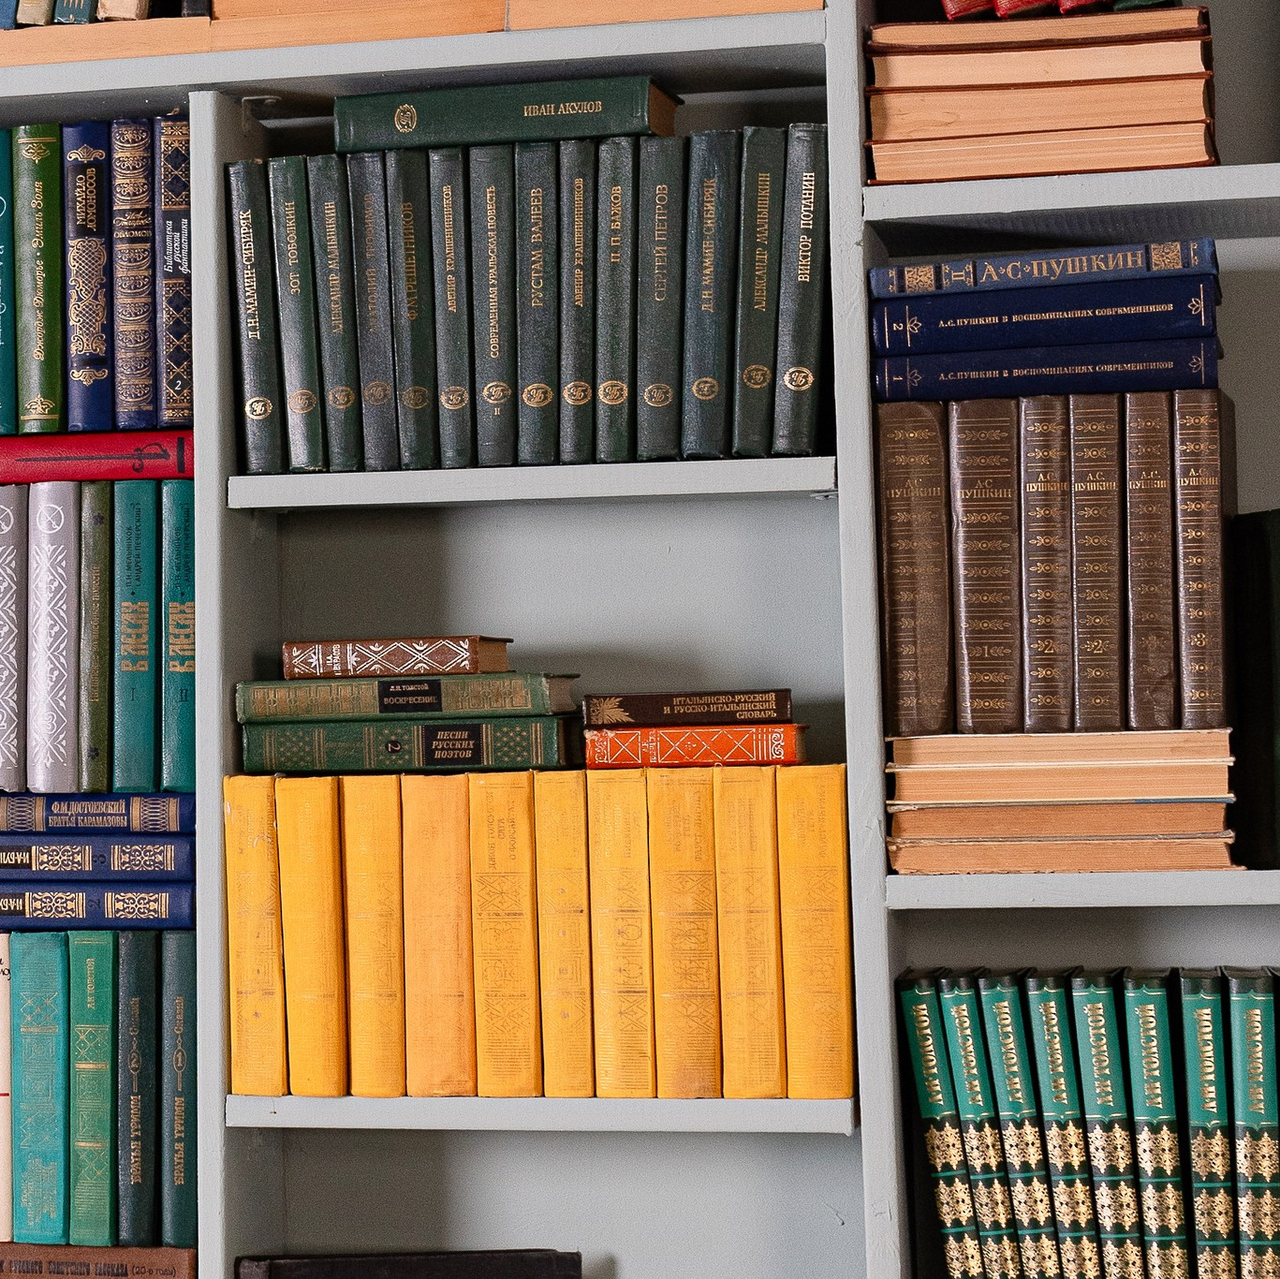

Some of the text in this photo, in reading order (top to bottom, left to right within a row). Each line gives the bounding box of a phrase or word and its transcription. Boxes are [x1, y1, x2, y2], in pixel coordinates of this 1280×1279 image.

[523, 100, 602, 117] ИВАН АКУЛОВ
[74, 174, 86, 225] МИХАЙЛО
[86, 167, 97, 232] ЛОМОНОСОВ
[610, 185, 622, 230] БАЖОВ
[164, 220, 175, 273] Библиотека
[171, 232, 182, 262] русской
[179, 218, 191, 274] фантастики
[284, 201, 301, 296] ЗОТ ТОБОЛКИН
[530, 187, 544, 307] РУСТАМ ВАЛЕЕВ
[653, 184, 669, 302] СЕРГЕЙ ПЕТРОВ
[754, 172, 771, 311] АЛЕКСАНДР МАЛЫШКИН
[798, 171, 815, 282] ВИКТОР ПОТАНИН
[31, 181, 46, 361] Джордж Дюморье Эмиль Золя
[486, 185, 500, 358] СОВРЕМЕННАЯ УРАЛЬСКАЯ ПОВЕСТЬ
[956, 487, 1012, 499] ПУШКИН
[672, 692, 777, 705] ИТАЛЬЯНСКО-РУССКИЙ
[673, 701, 777, 714] РУССКО-ИТАЛЬЯНСКИЙ
[735, 710, 777, 719] СЛОВАРЬ
[431, 739, 475, 749] РУССКИХ
[433, 748, 472, 758] ПОЭТОВ
[436, 730, 468, 740] ПЕСНИ
[48, 816, 128, 827] БРАТЬЯ КАРАМАЗОВЫ
[130, 1094, 141, 1185] БРАТЬЯ ГРИММ
